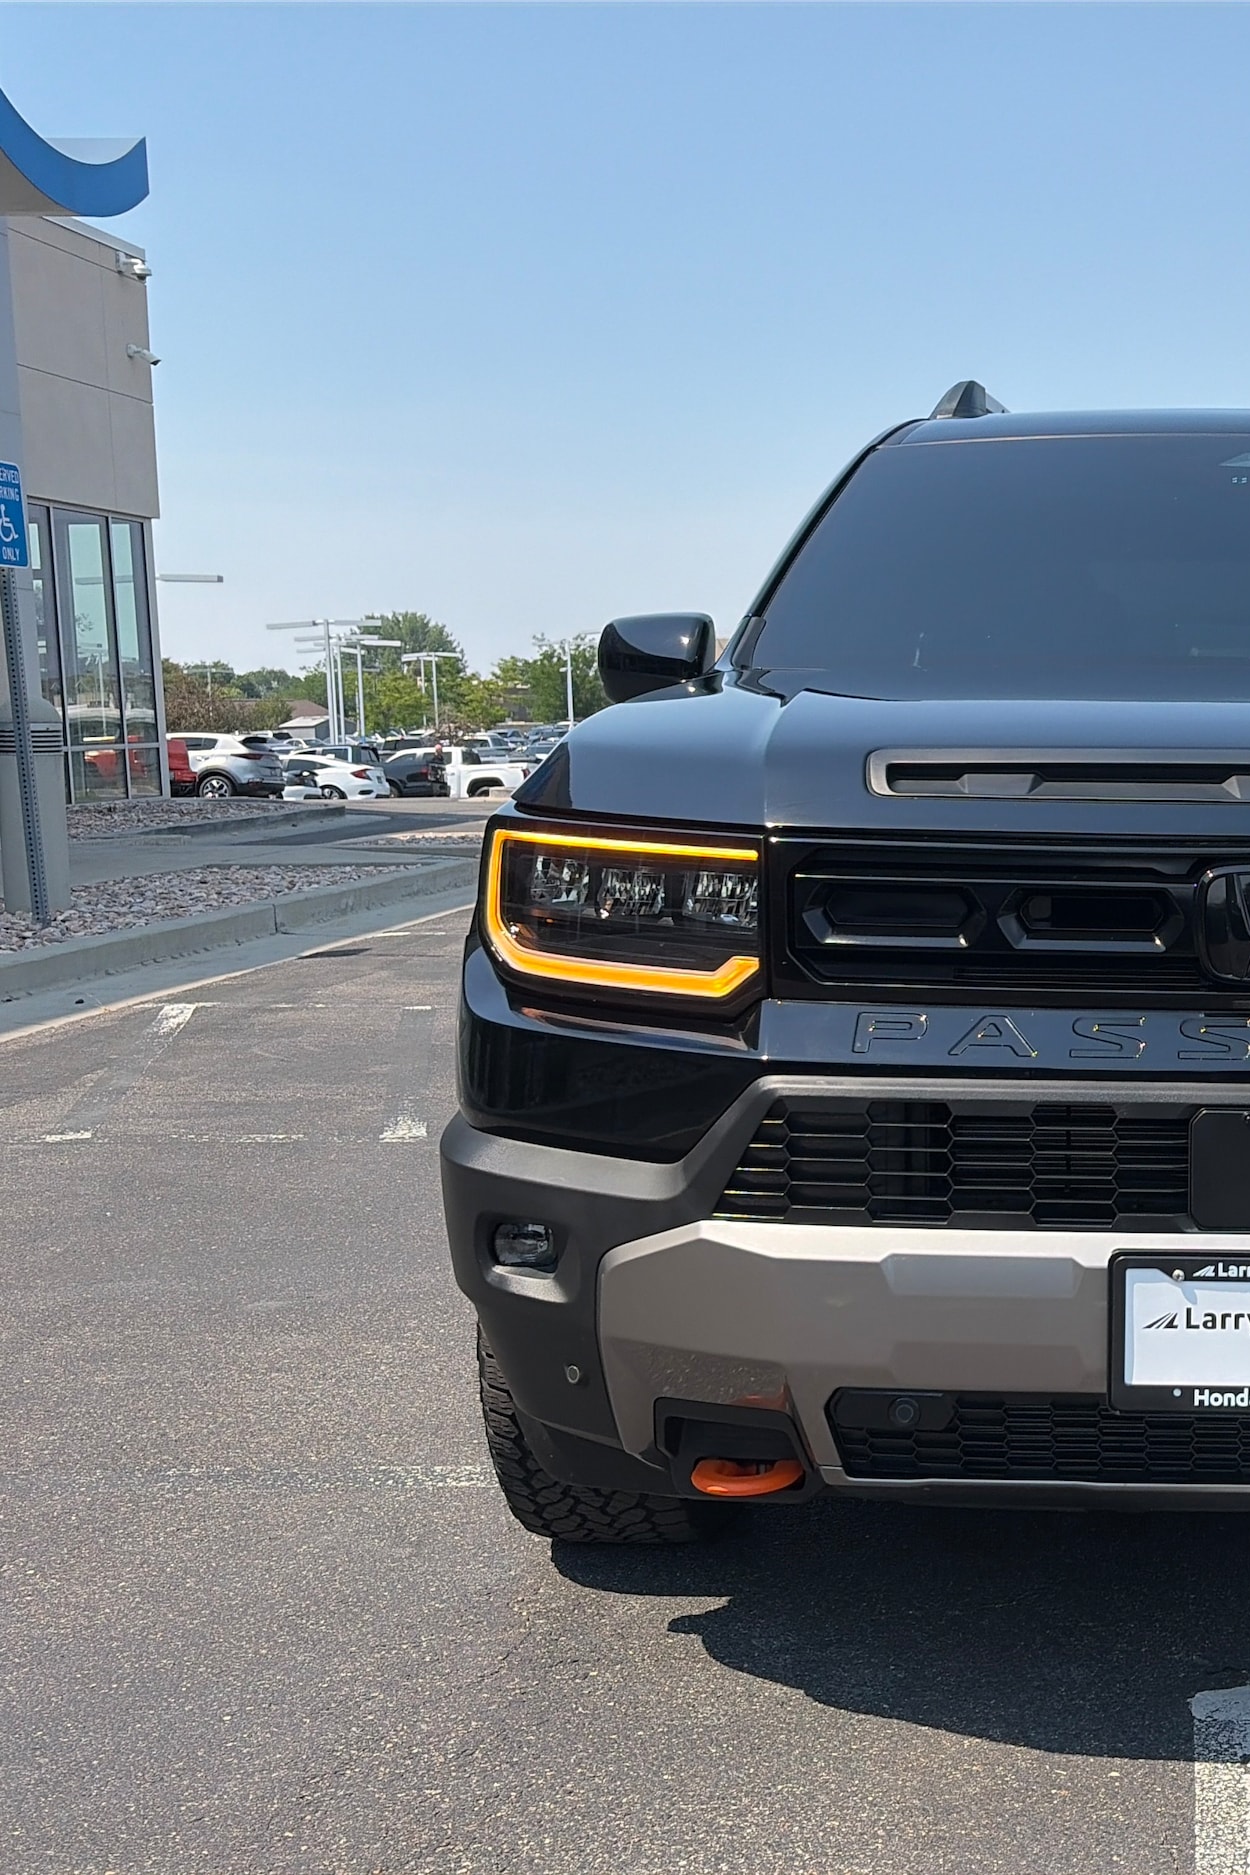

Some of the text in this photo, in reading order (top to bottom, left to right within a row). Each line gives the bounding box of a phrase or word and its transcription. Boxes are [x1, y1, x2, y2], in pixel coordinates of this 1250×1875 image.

[0, 467, 19, 484] ERVED
[0, 487, 20, 502] RKING
[2, 547, 20, 562] ONLY
